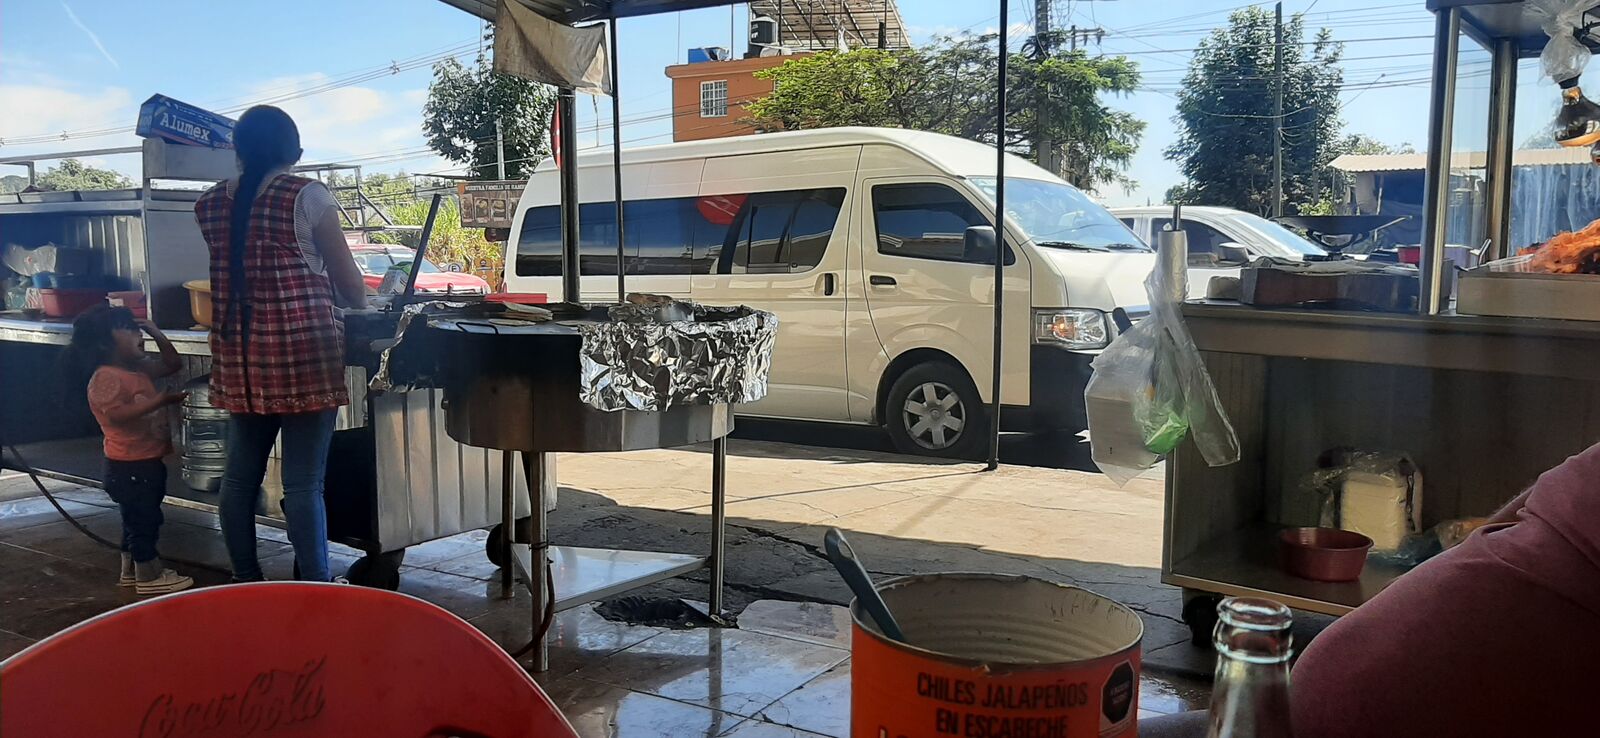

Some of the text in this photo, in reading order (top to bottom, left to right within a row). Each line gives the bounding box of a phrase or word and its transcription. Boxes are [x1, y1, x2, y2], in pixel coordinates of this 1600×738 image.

[160, 112, 211, 141] Alumex
[916, 671, 976, 705] CHILES
[982, 679, 1088, 710] JALAPEÑOS
[935, 707, 960, 735] EN
[964, 713, 1069, 738] ESCABECHE
